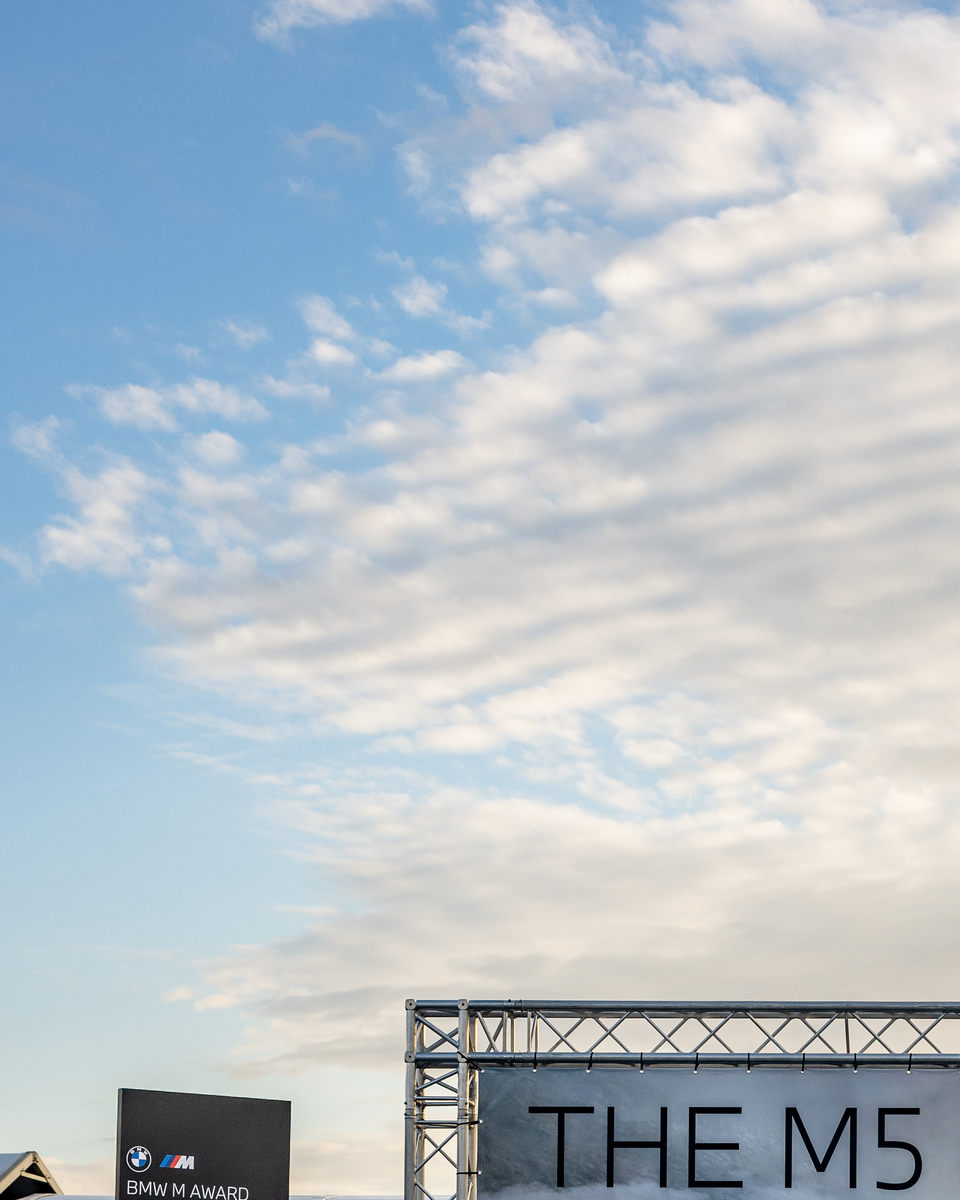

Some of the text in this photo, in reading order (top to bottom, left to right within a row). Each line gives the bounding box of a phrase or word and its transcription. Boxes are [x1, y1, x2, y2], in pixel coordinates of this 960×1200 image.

[528, 1106, 743, 1188] THE
[784, 1106, 923, 1191] M5
[126, 1180, 168, 1197] BMW
[172, 1183, 185, 1198] M
